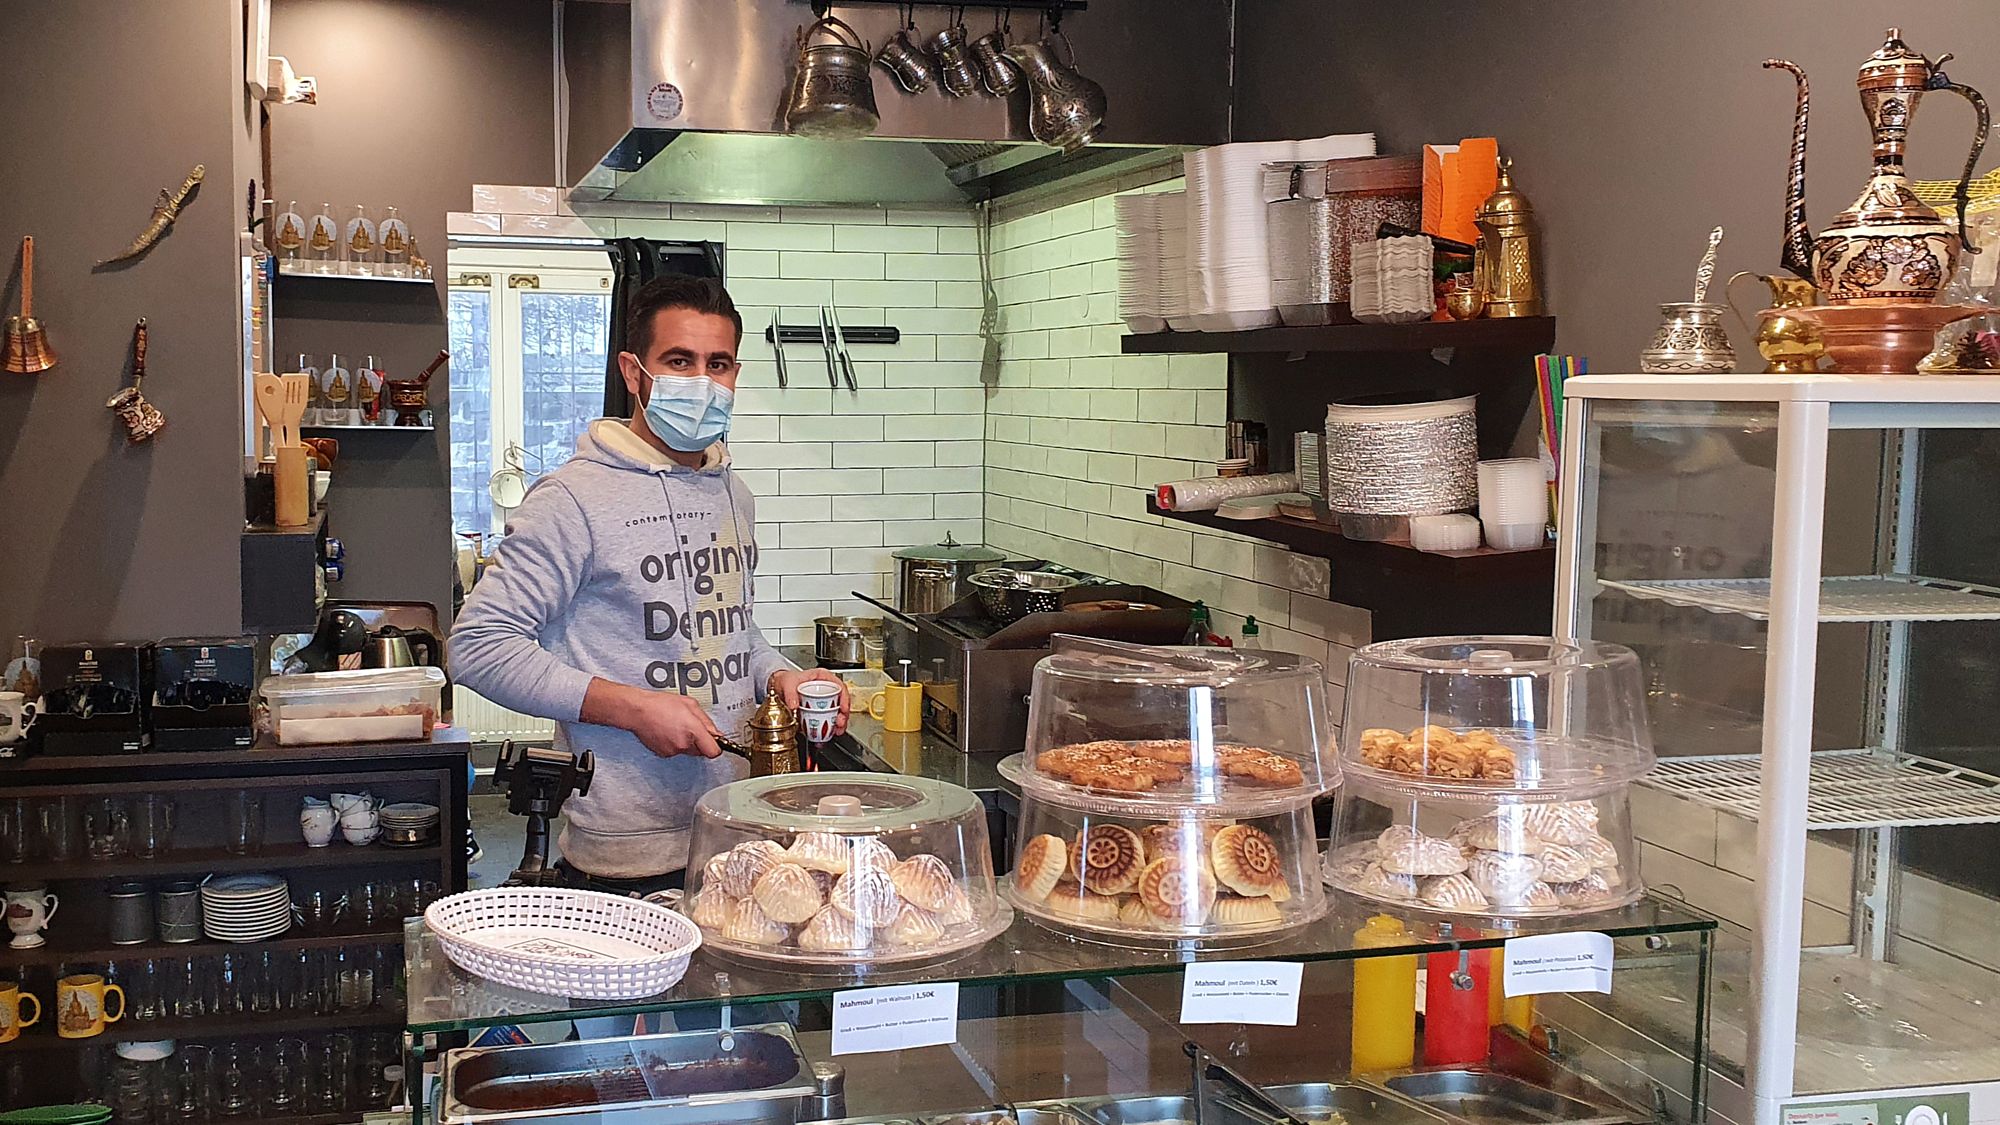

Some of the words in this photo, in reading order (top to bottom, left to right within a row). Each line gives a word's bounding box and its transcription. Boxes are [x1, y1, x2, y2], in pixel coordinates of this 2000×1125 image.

[645, 651, 751, 705] appar
[1194, 979, 1226, 987] Mahmoul
[840, 997, 874, 1009] Mahmoul
[916, 990, 935, 1000] 1,50€
